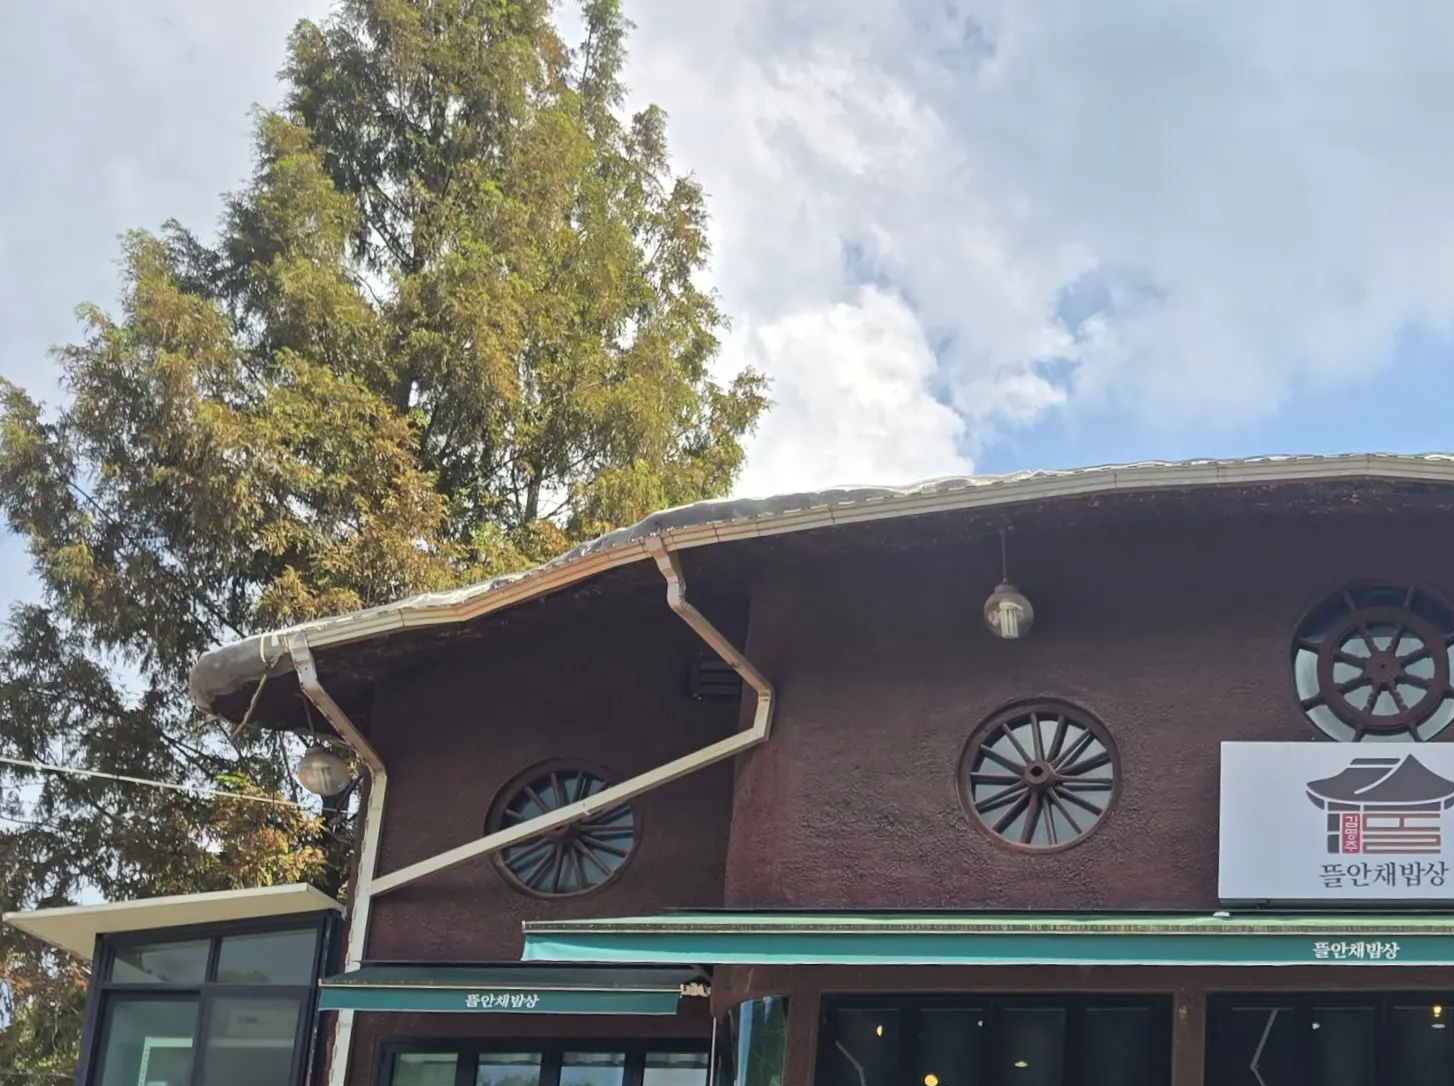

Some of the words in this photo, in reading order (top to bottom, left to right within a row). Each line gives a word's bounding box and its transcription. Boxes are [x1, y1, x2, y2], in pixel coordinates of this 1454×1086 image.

[1319, 860, 1450, 888] 뜰안채밥상
[1312, 941, 1400, 960] 뜰안채밥상
[465, 993, 540, 1008] 뜰안채밥상
